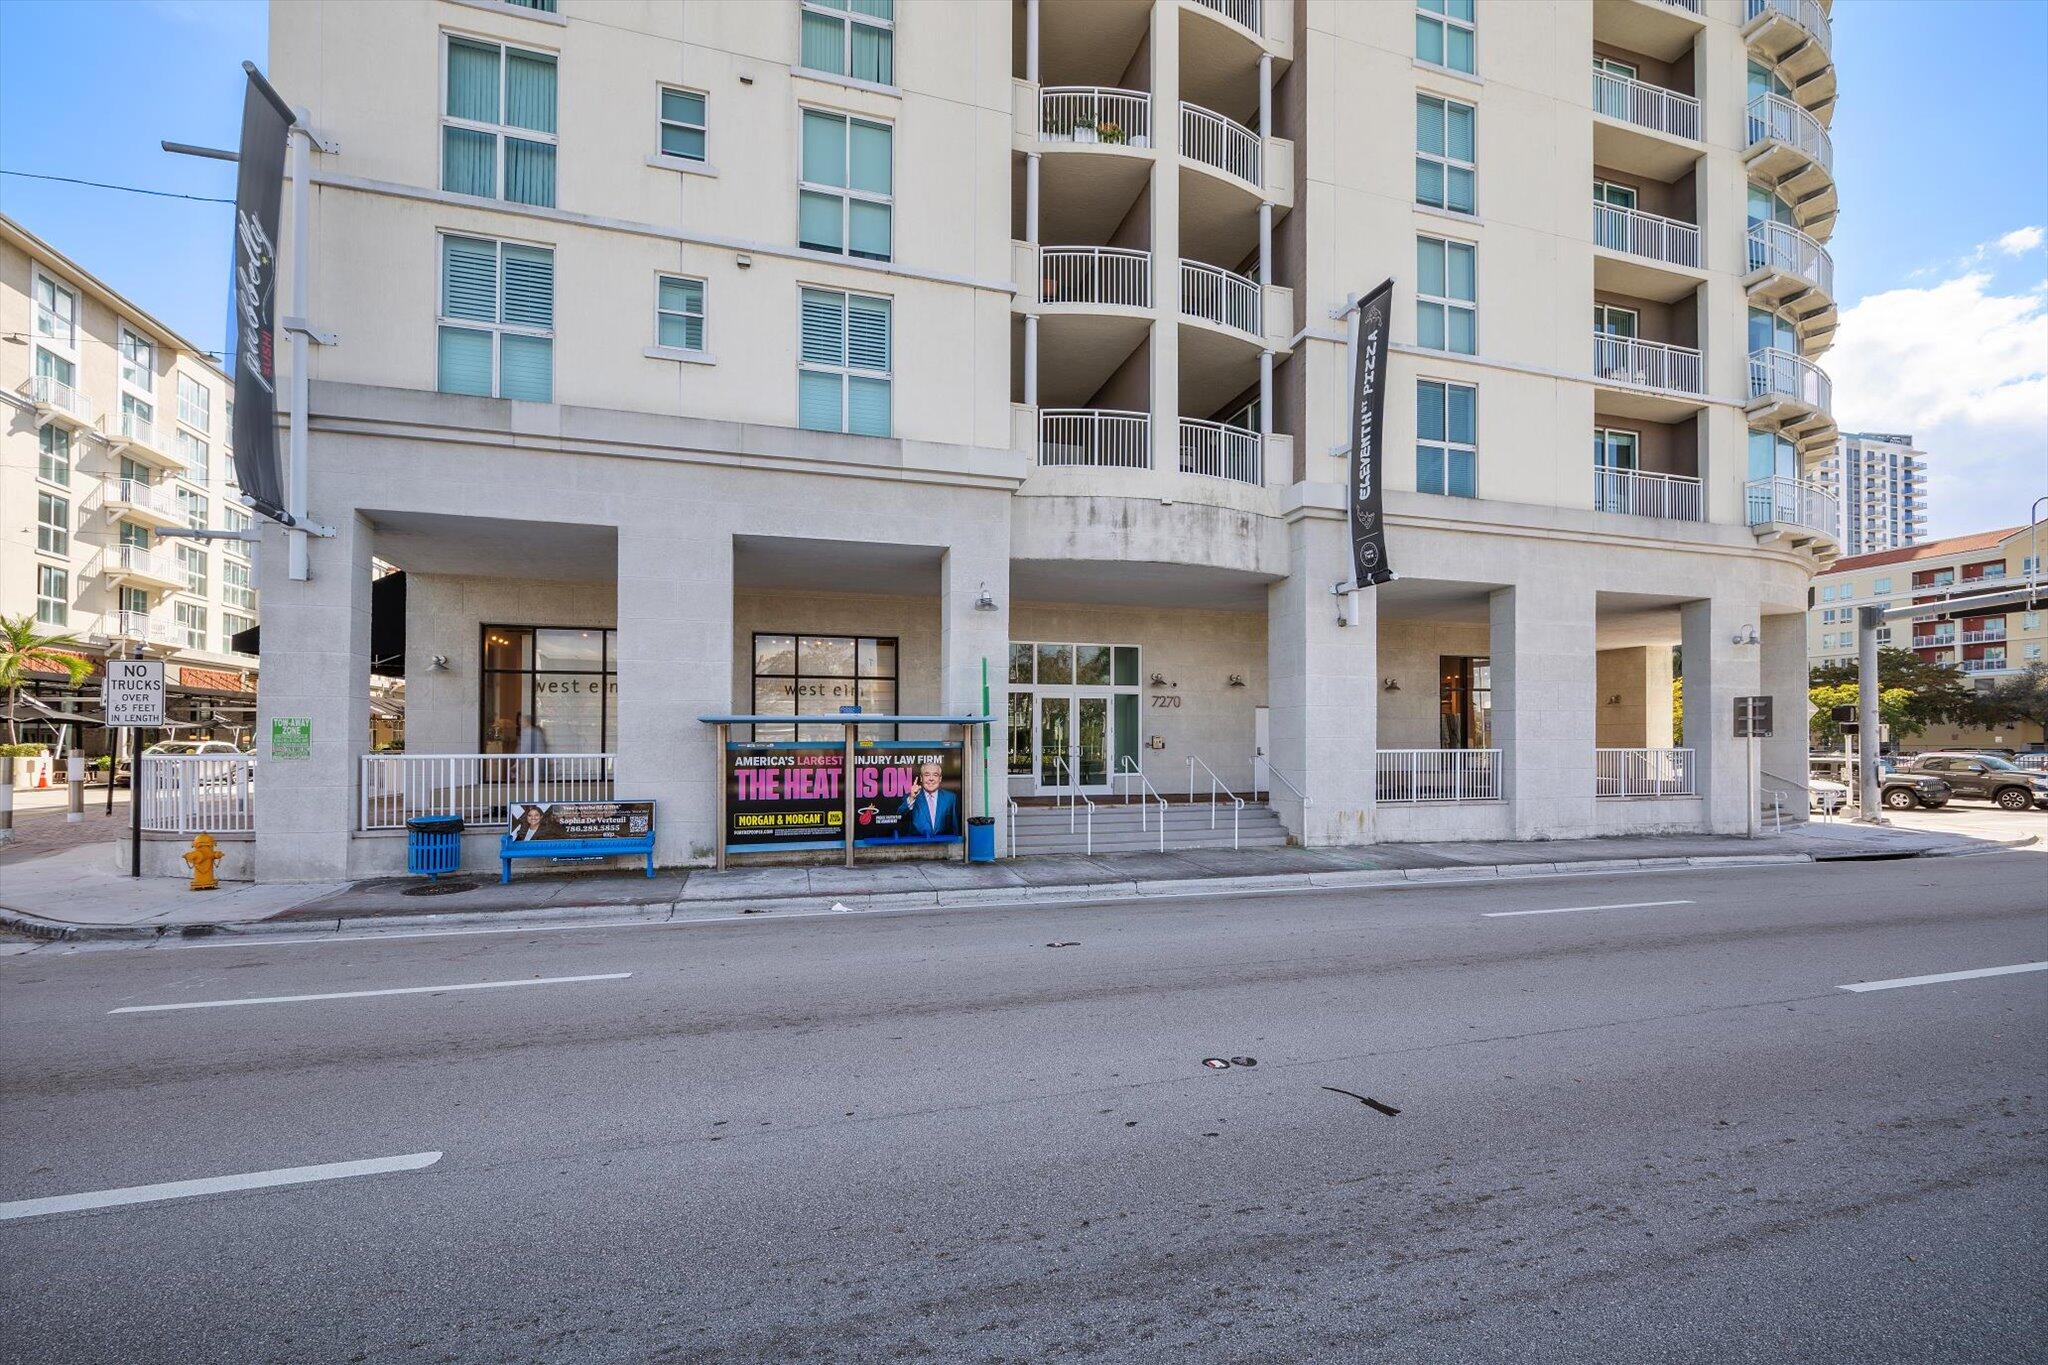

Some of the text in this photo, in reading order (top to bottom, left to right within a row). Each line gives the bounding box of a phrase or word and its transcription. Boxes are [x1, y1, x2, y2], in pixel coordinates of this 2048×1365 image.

[262, 330, 273, 378] SUSHI
[1363, 329, 1378, 395] PIZZA
[1360, 411, 1372, 500] ELEVENTH
[124, 665, 147, 677] NO
[111, 680, 161, 690] TRUCKS
[785, 684, 825, 696] west
[1152, 695, 1181, 708] 7270
[125, 714, 160, 722] LENGTH
[735, 755, 943, 767] AMERICA'S LARGEST INJURY LAW FIRM
[734, 767, 913, 801] THE HEAT IS ON
[559, 816, 585, 826] Sophia
[586, 816, 597, 824] De
[739, 815, 775, 826] MORGAN
[777, 815, 784, 825] &
[785, 814, 821, 825] MORGAN
